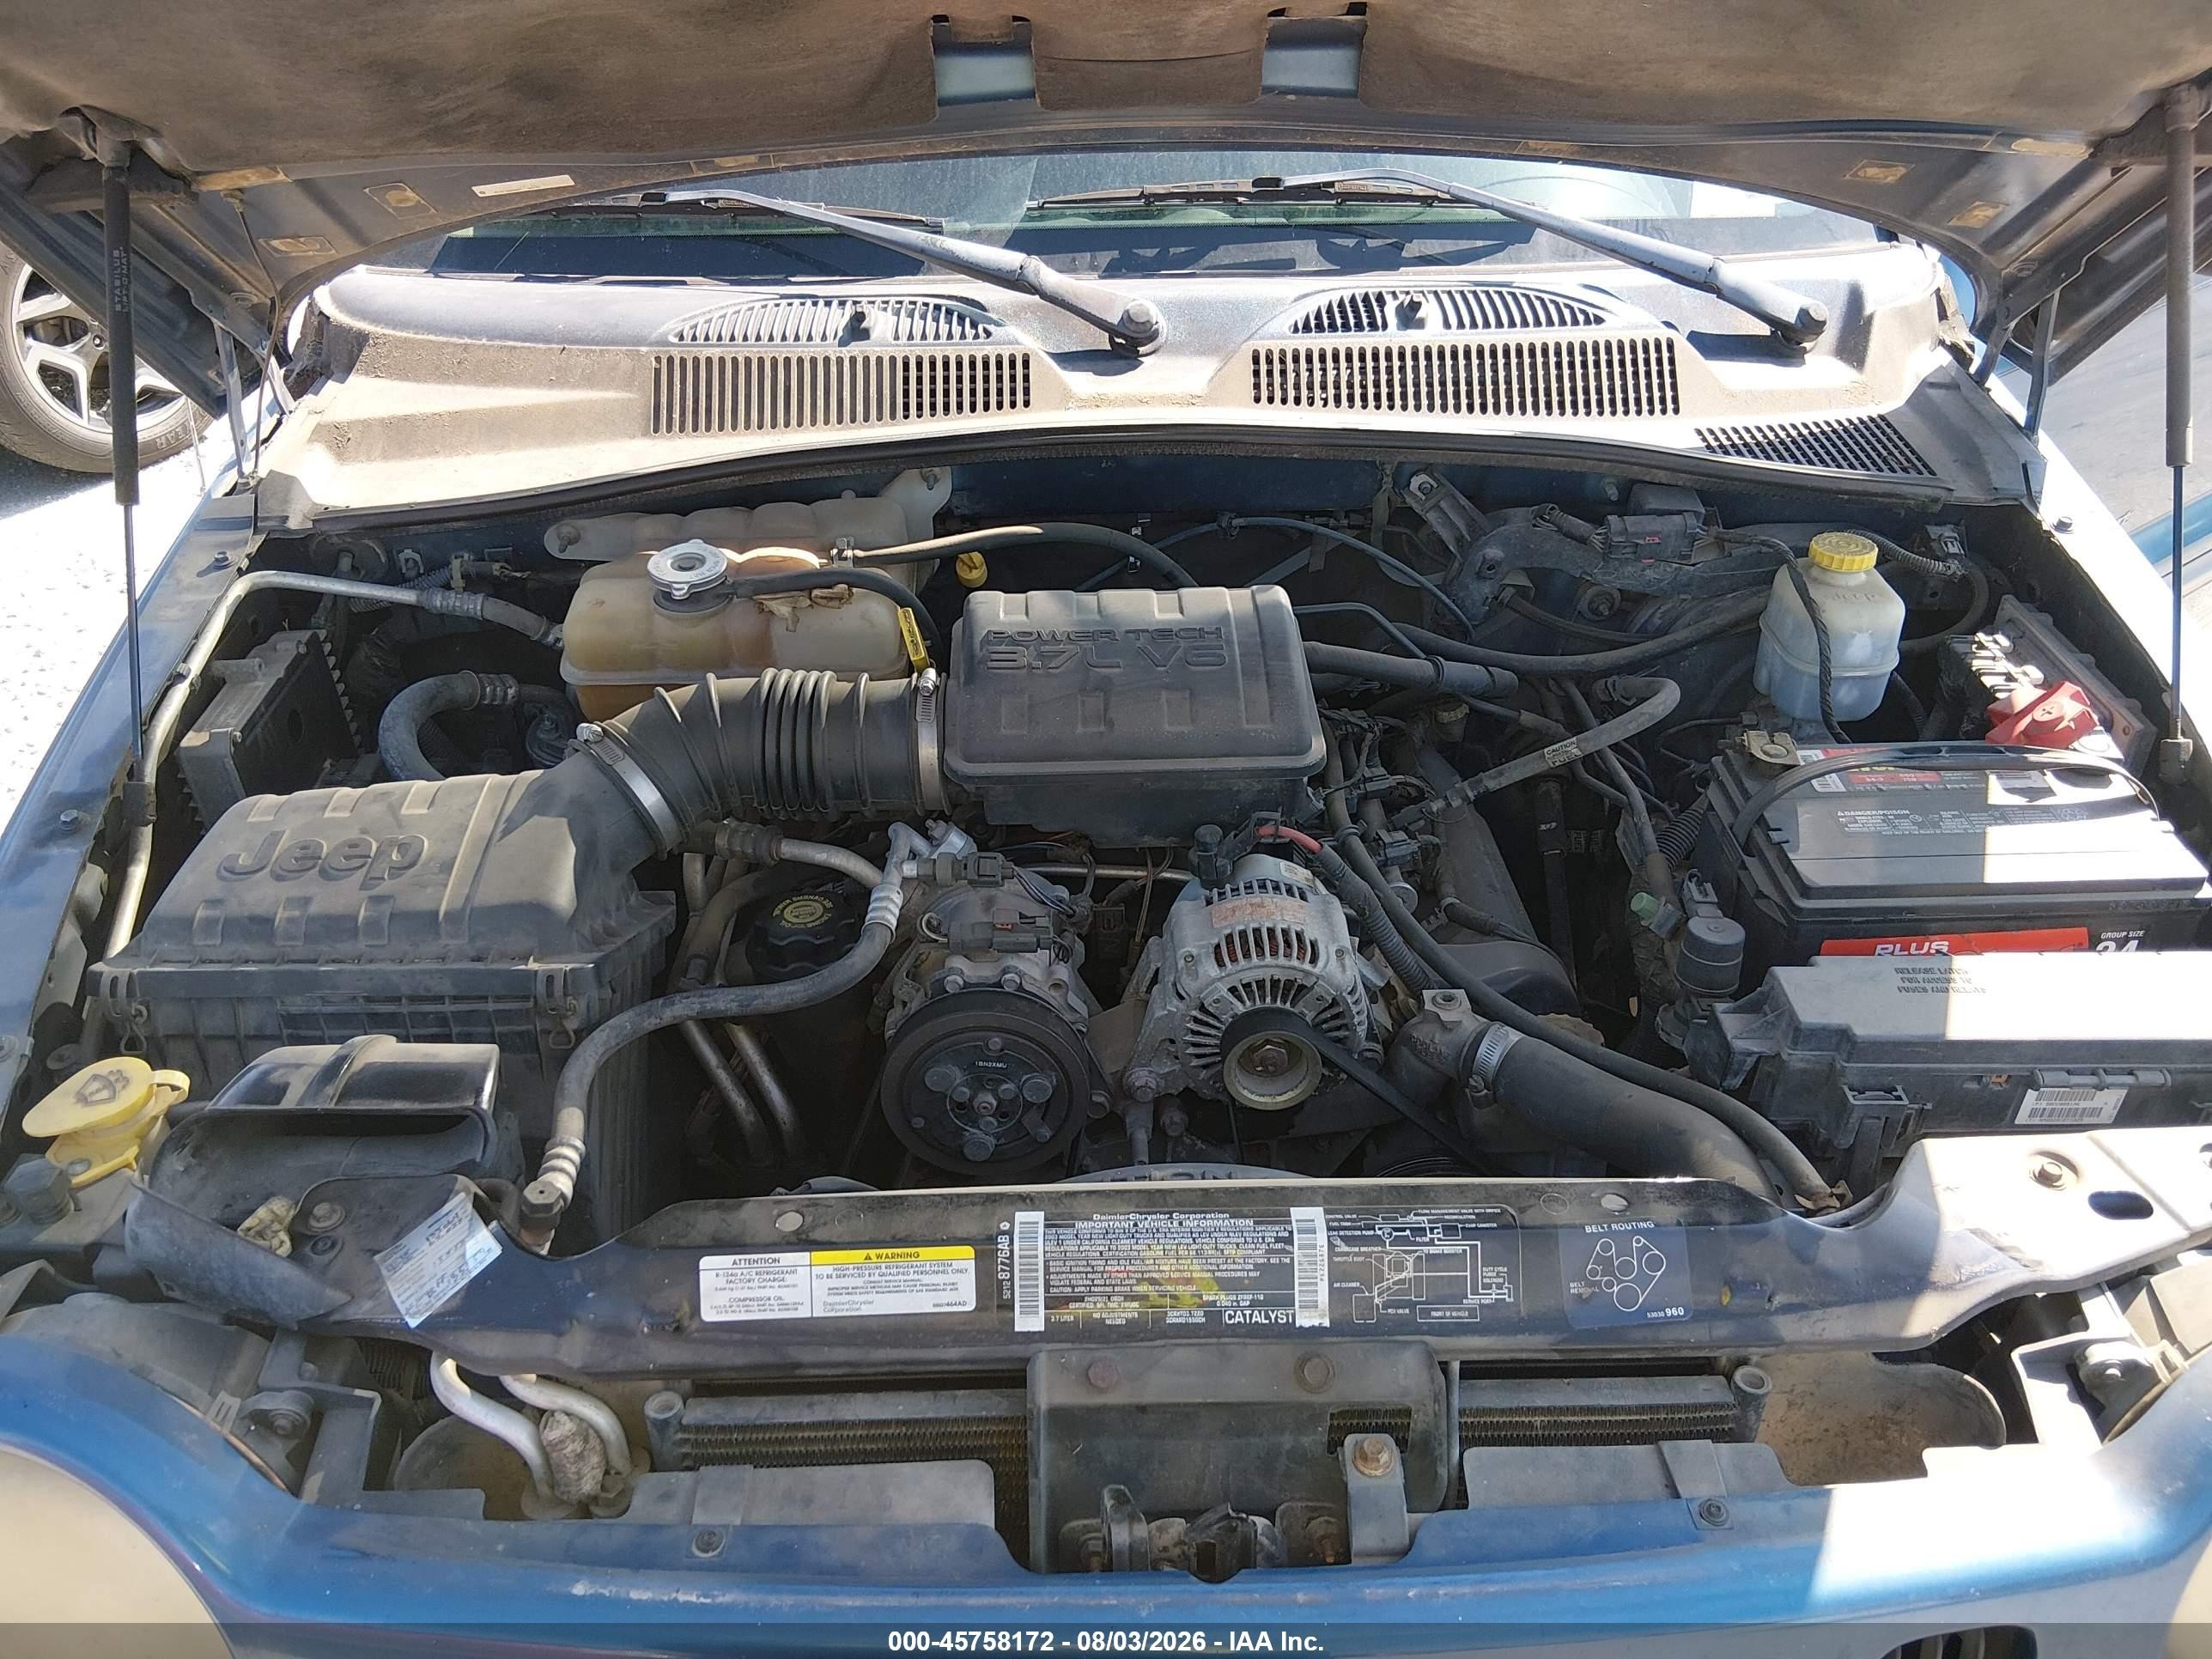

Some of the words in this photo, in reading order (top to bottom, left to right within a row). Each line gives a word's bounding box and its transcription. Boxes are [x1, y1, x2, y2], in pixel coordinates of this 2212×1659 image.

[984, 627, 1121, 642] POWER
[1125, 625, 1224, 641] TECH
[985, 644, 1122, 671] 3.7L
[1137, 643, 1229, 670] V6
[1546, 740, 1576, 755] CAUTION
[216, 828, 428, 890] Jeep
[2100, 931, 2126, 939] GROUP
[1875, 940, 1949, 956] PLUS
[1092, 1212, 1170, 1222] DaimlerChrysler
[1172, 1212, 1230, 1220] Corporation
[1182, 1218, 1254, 1227] INFORMATION
[1585, 1224, 1609, 1233] BELT
[1611, 1221, 1656, 1231] ROUTING
[875, 1251, 921, 1260] WARNING
[732, 1257, 781, 1266] ATTENTION
[755, 1268, 798, 1277] REFRIGERANT
[832, 1264, 883, 1273] HIGH-PRESSURE
[1225, 1310, 1294, 1324] CATALYST
